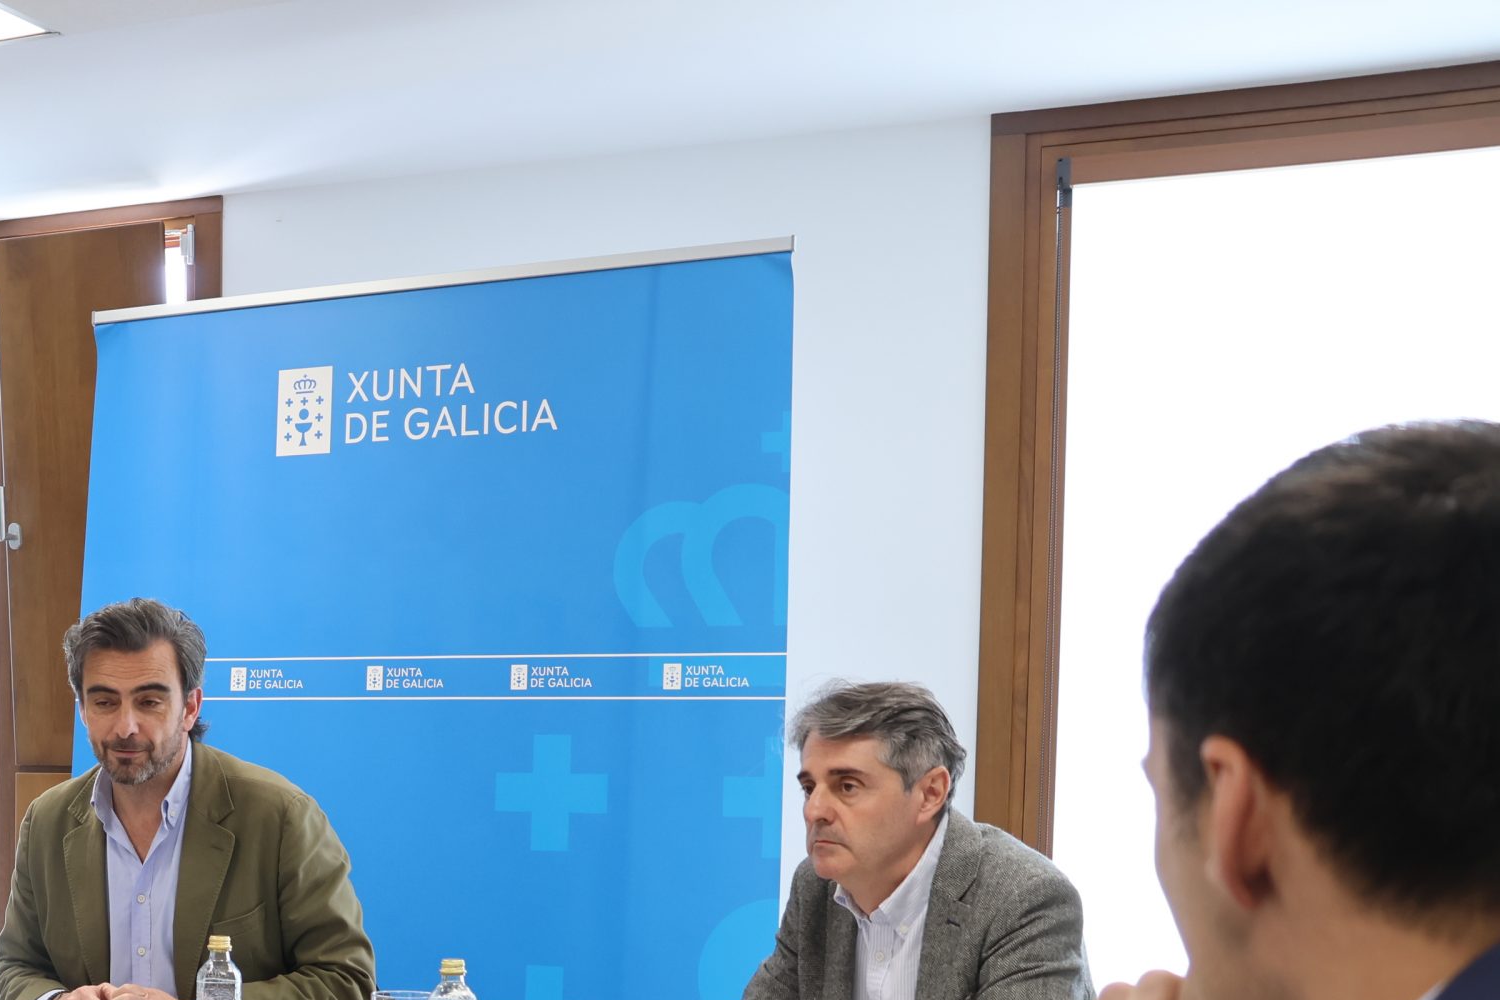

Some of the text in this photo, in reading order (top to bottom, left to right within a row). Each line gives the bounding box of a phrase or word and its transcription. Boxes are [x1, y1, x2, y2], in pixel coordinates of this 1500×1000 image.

[347, 363, 475, 403] XUNTA
[345, 399, 558, 444] DE GALICIA
[250, 669, 283, 678] XUNTA
[386, 668, 422, 678] XUNTA
[531, 666, 569, 676] XUNTA
[685, 665, 724, 676] XUNTA
[249, 679, 303, 689] DE GALICIA
[386, 678, 443, 688] DE GALICIA
[530, 677, 592, 688] DE GALICIA
[685, 677, 749, 687] DE GALICIA
